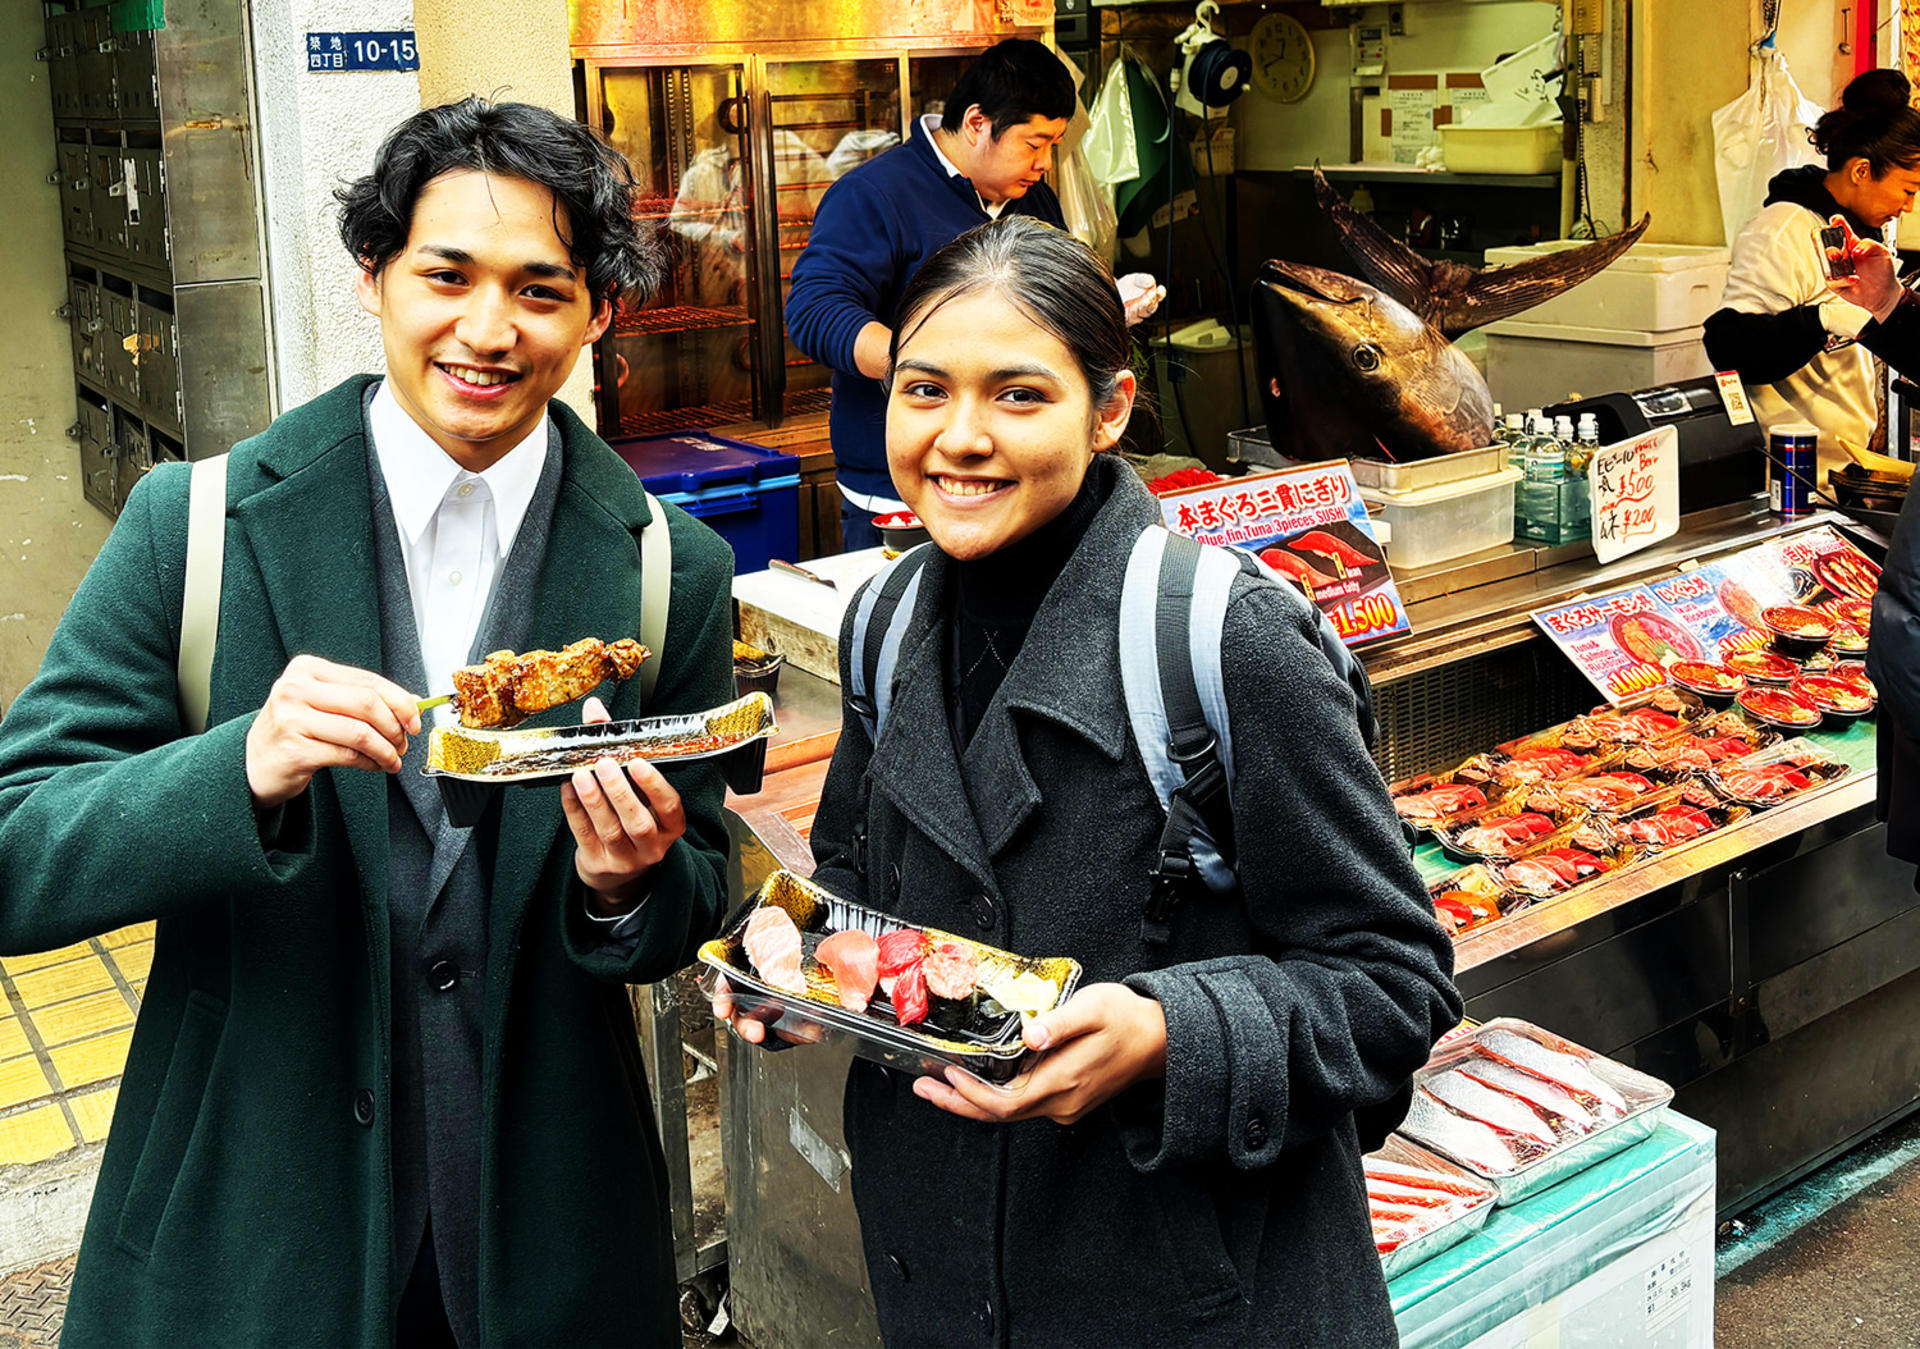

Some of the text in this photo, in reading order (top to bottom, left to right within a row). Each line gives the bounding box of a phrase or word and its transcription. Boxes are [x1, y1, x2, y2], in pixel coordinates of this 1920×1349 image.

[310, 53, 343, 68] 四丁目
[354, 39, 416, 62] 10-15
[1177, 474, 1350, 532] 本まぐろ三貫にぎり
[1226, 528, 1245, 543] fin
[1244, 521, 1273, 539] Tuna
[1273, 514, 1316, 534] 3pieces
[1315, 506, 1348, 524] SUSHI
[1547, 592, 1654, 633] まぐろサーモン丼
